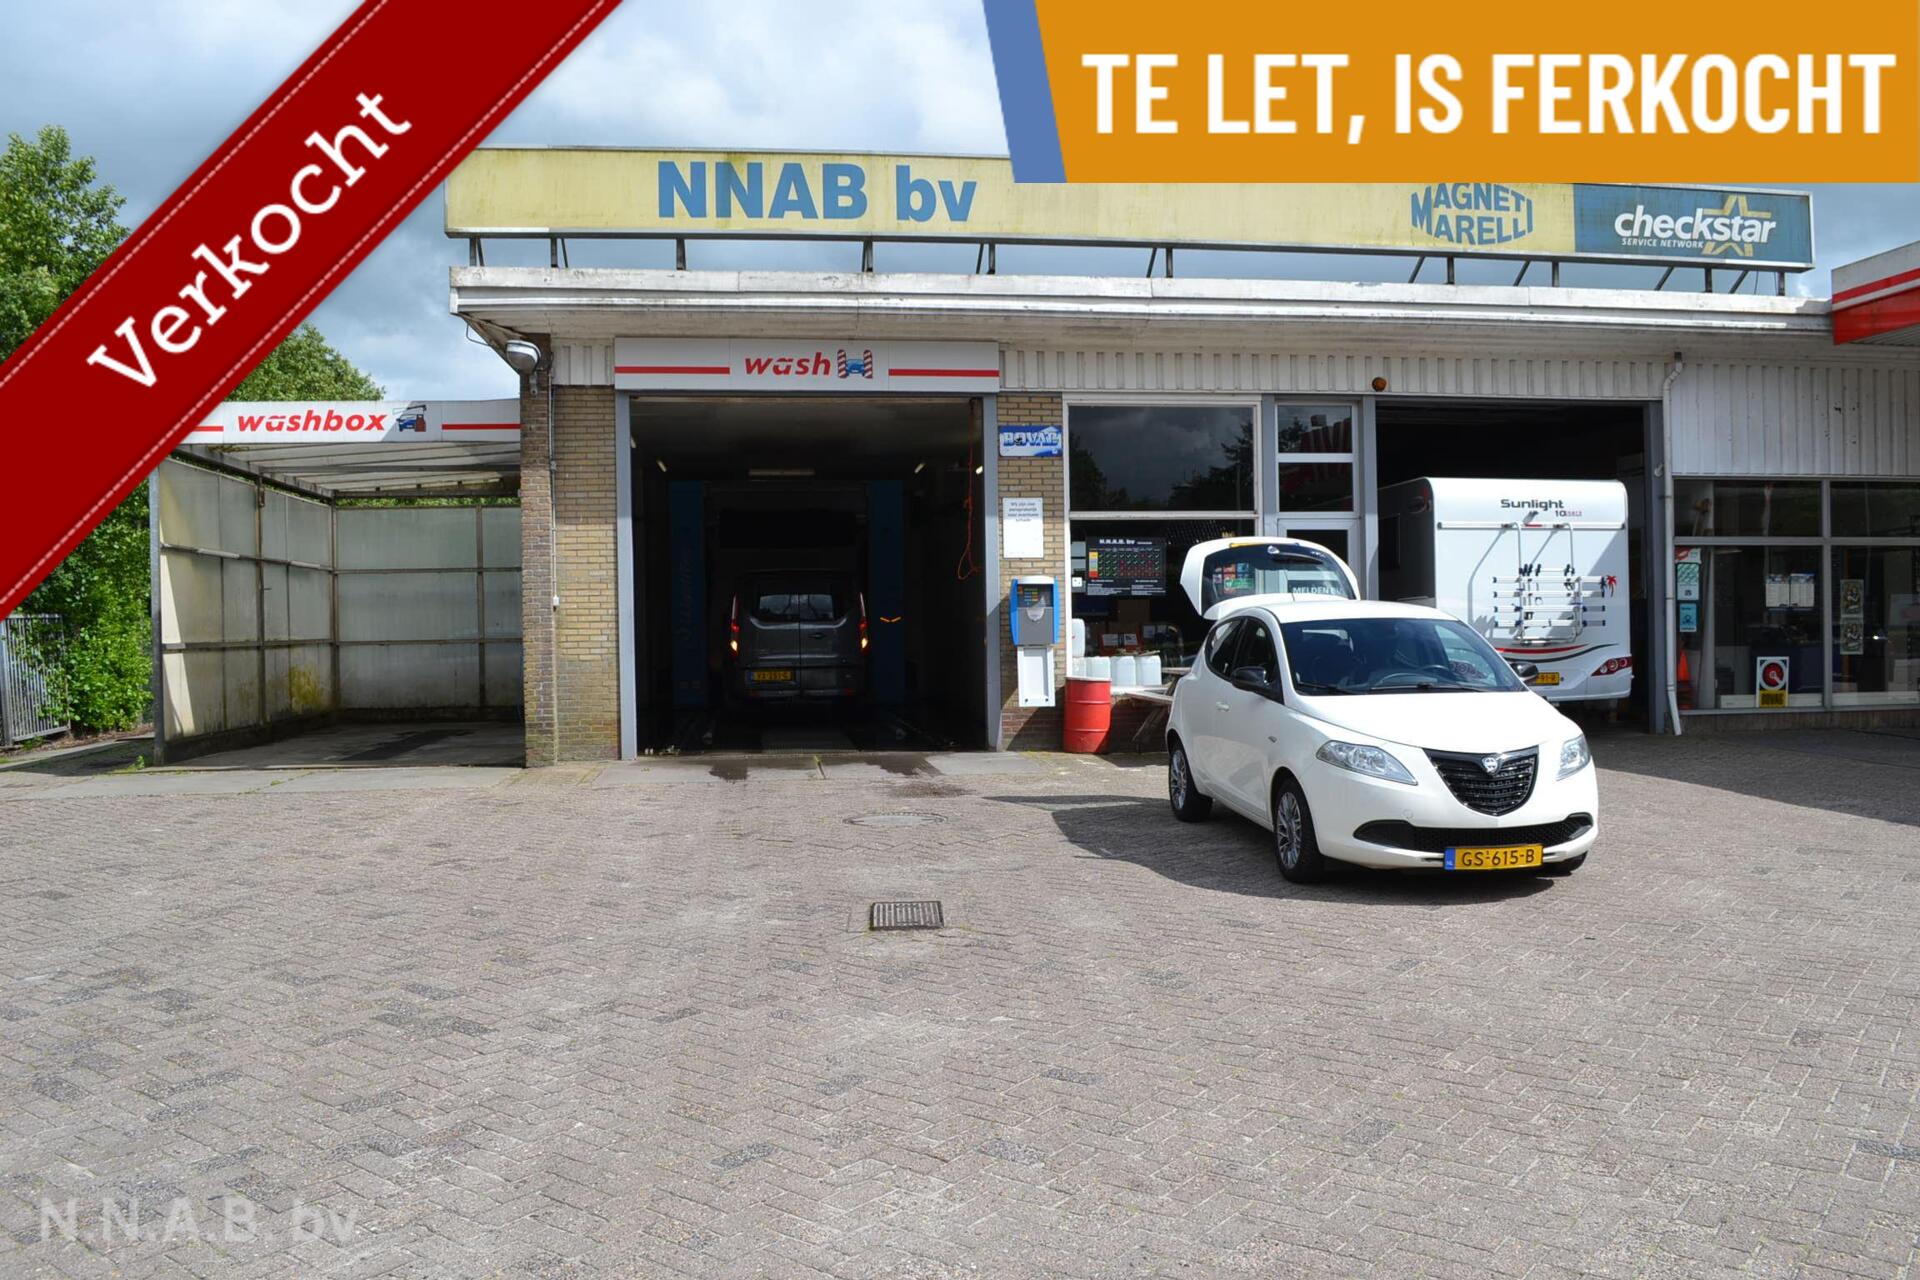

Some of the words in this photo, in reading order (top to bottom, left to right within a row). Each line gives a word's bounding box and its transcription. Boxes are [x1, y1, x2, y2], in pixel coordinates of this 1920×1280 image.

[657, 160, 868, 220] NNAB
[895, 164, 977, 222] bv
[1614, 204, 1776, 244] checkstar
[1621, 237, 1657, 247] SERVICE
[1660, 239, 1704, 249] NETWORK
[745, 352, 831, 376] wash
[237, 408, 388, 432] washbox
[1500, 498, 1564, 512] Sunlight
